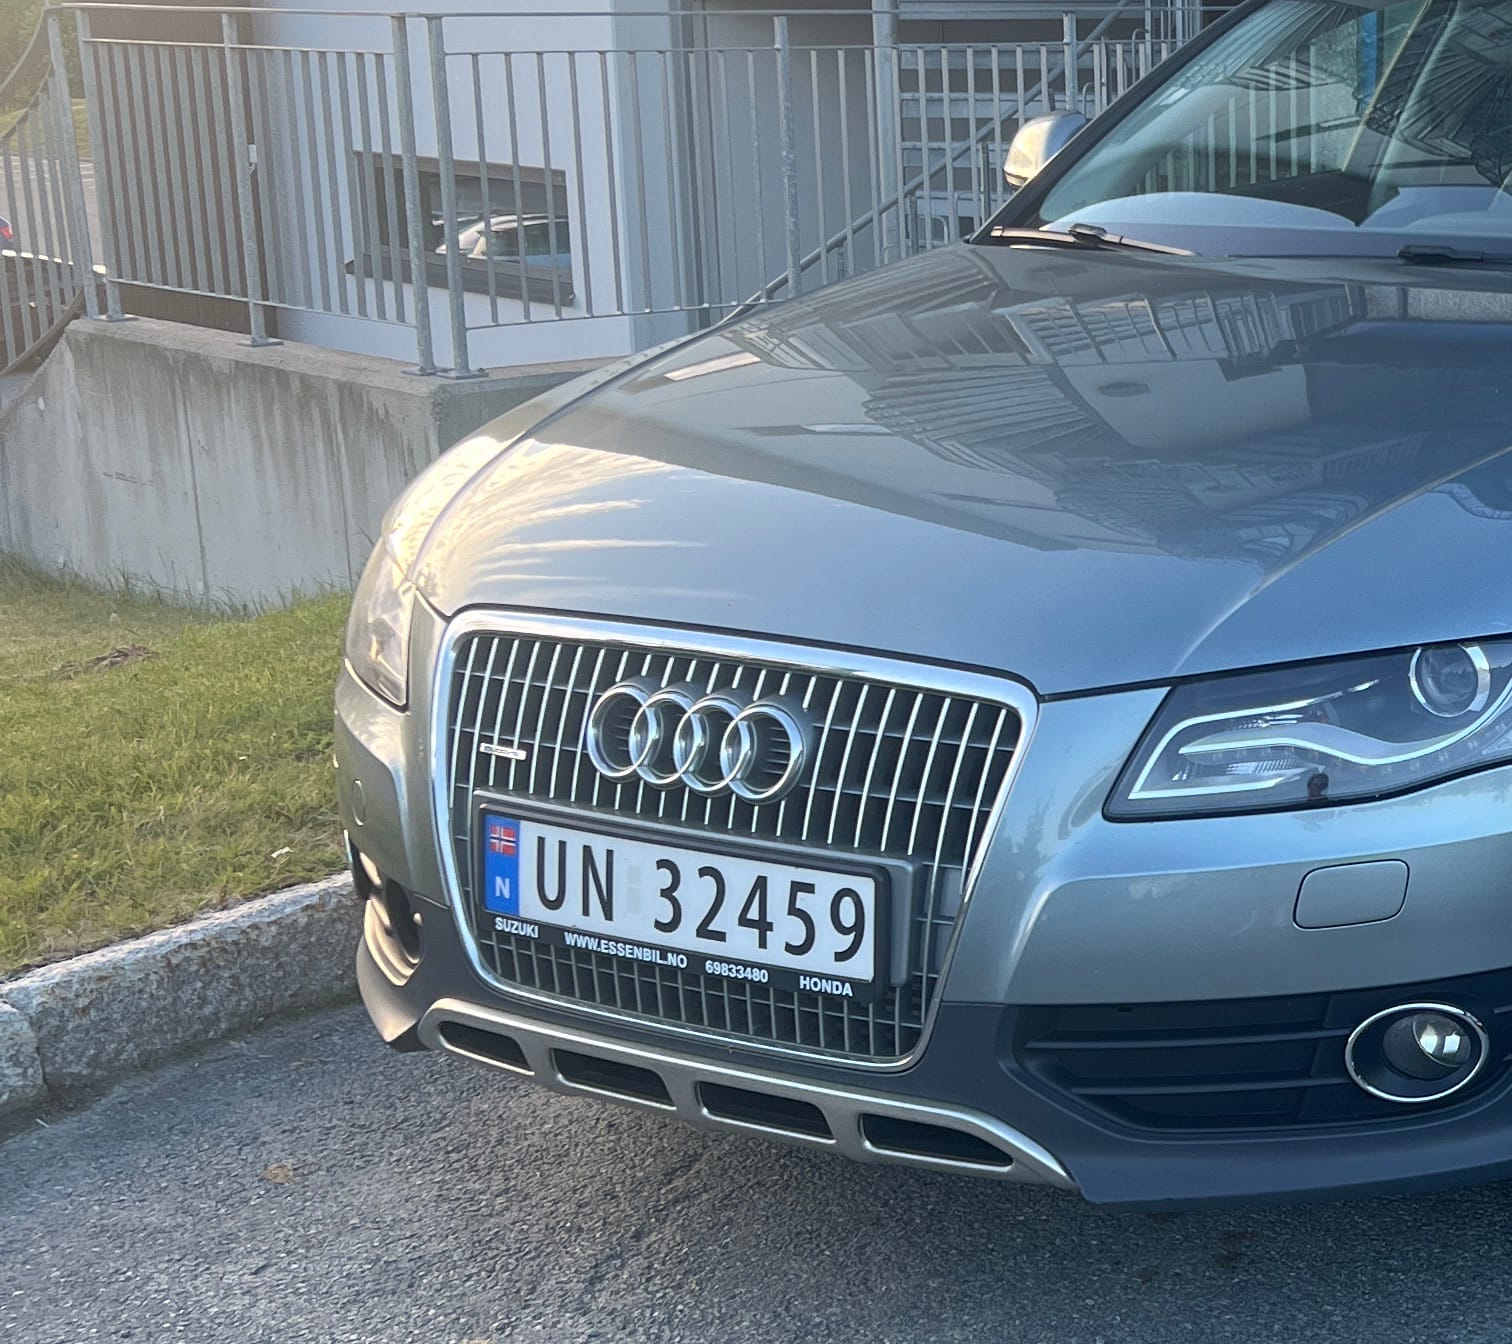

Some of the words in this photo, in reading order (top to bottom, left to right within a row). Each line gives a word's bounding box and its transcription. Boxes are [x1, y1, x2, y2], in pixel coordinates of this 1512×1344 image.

[495, 876, 511, 899] N
[536, 836, 614, 921] UN
[654, 858, 866, 963] 32459
[495, 917, 539, 939] SUZUKI
[564, 931, 688, 969] WWW.ESSENBIL.NO
[705, 960, 769, 984] 69833480
[800, 975, 853, 997] HONDA
